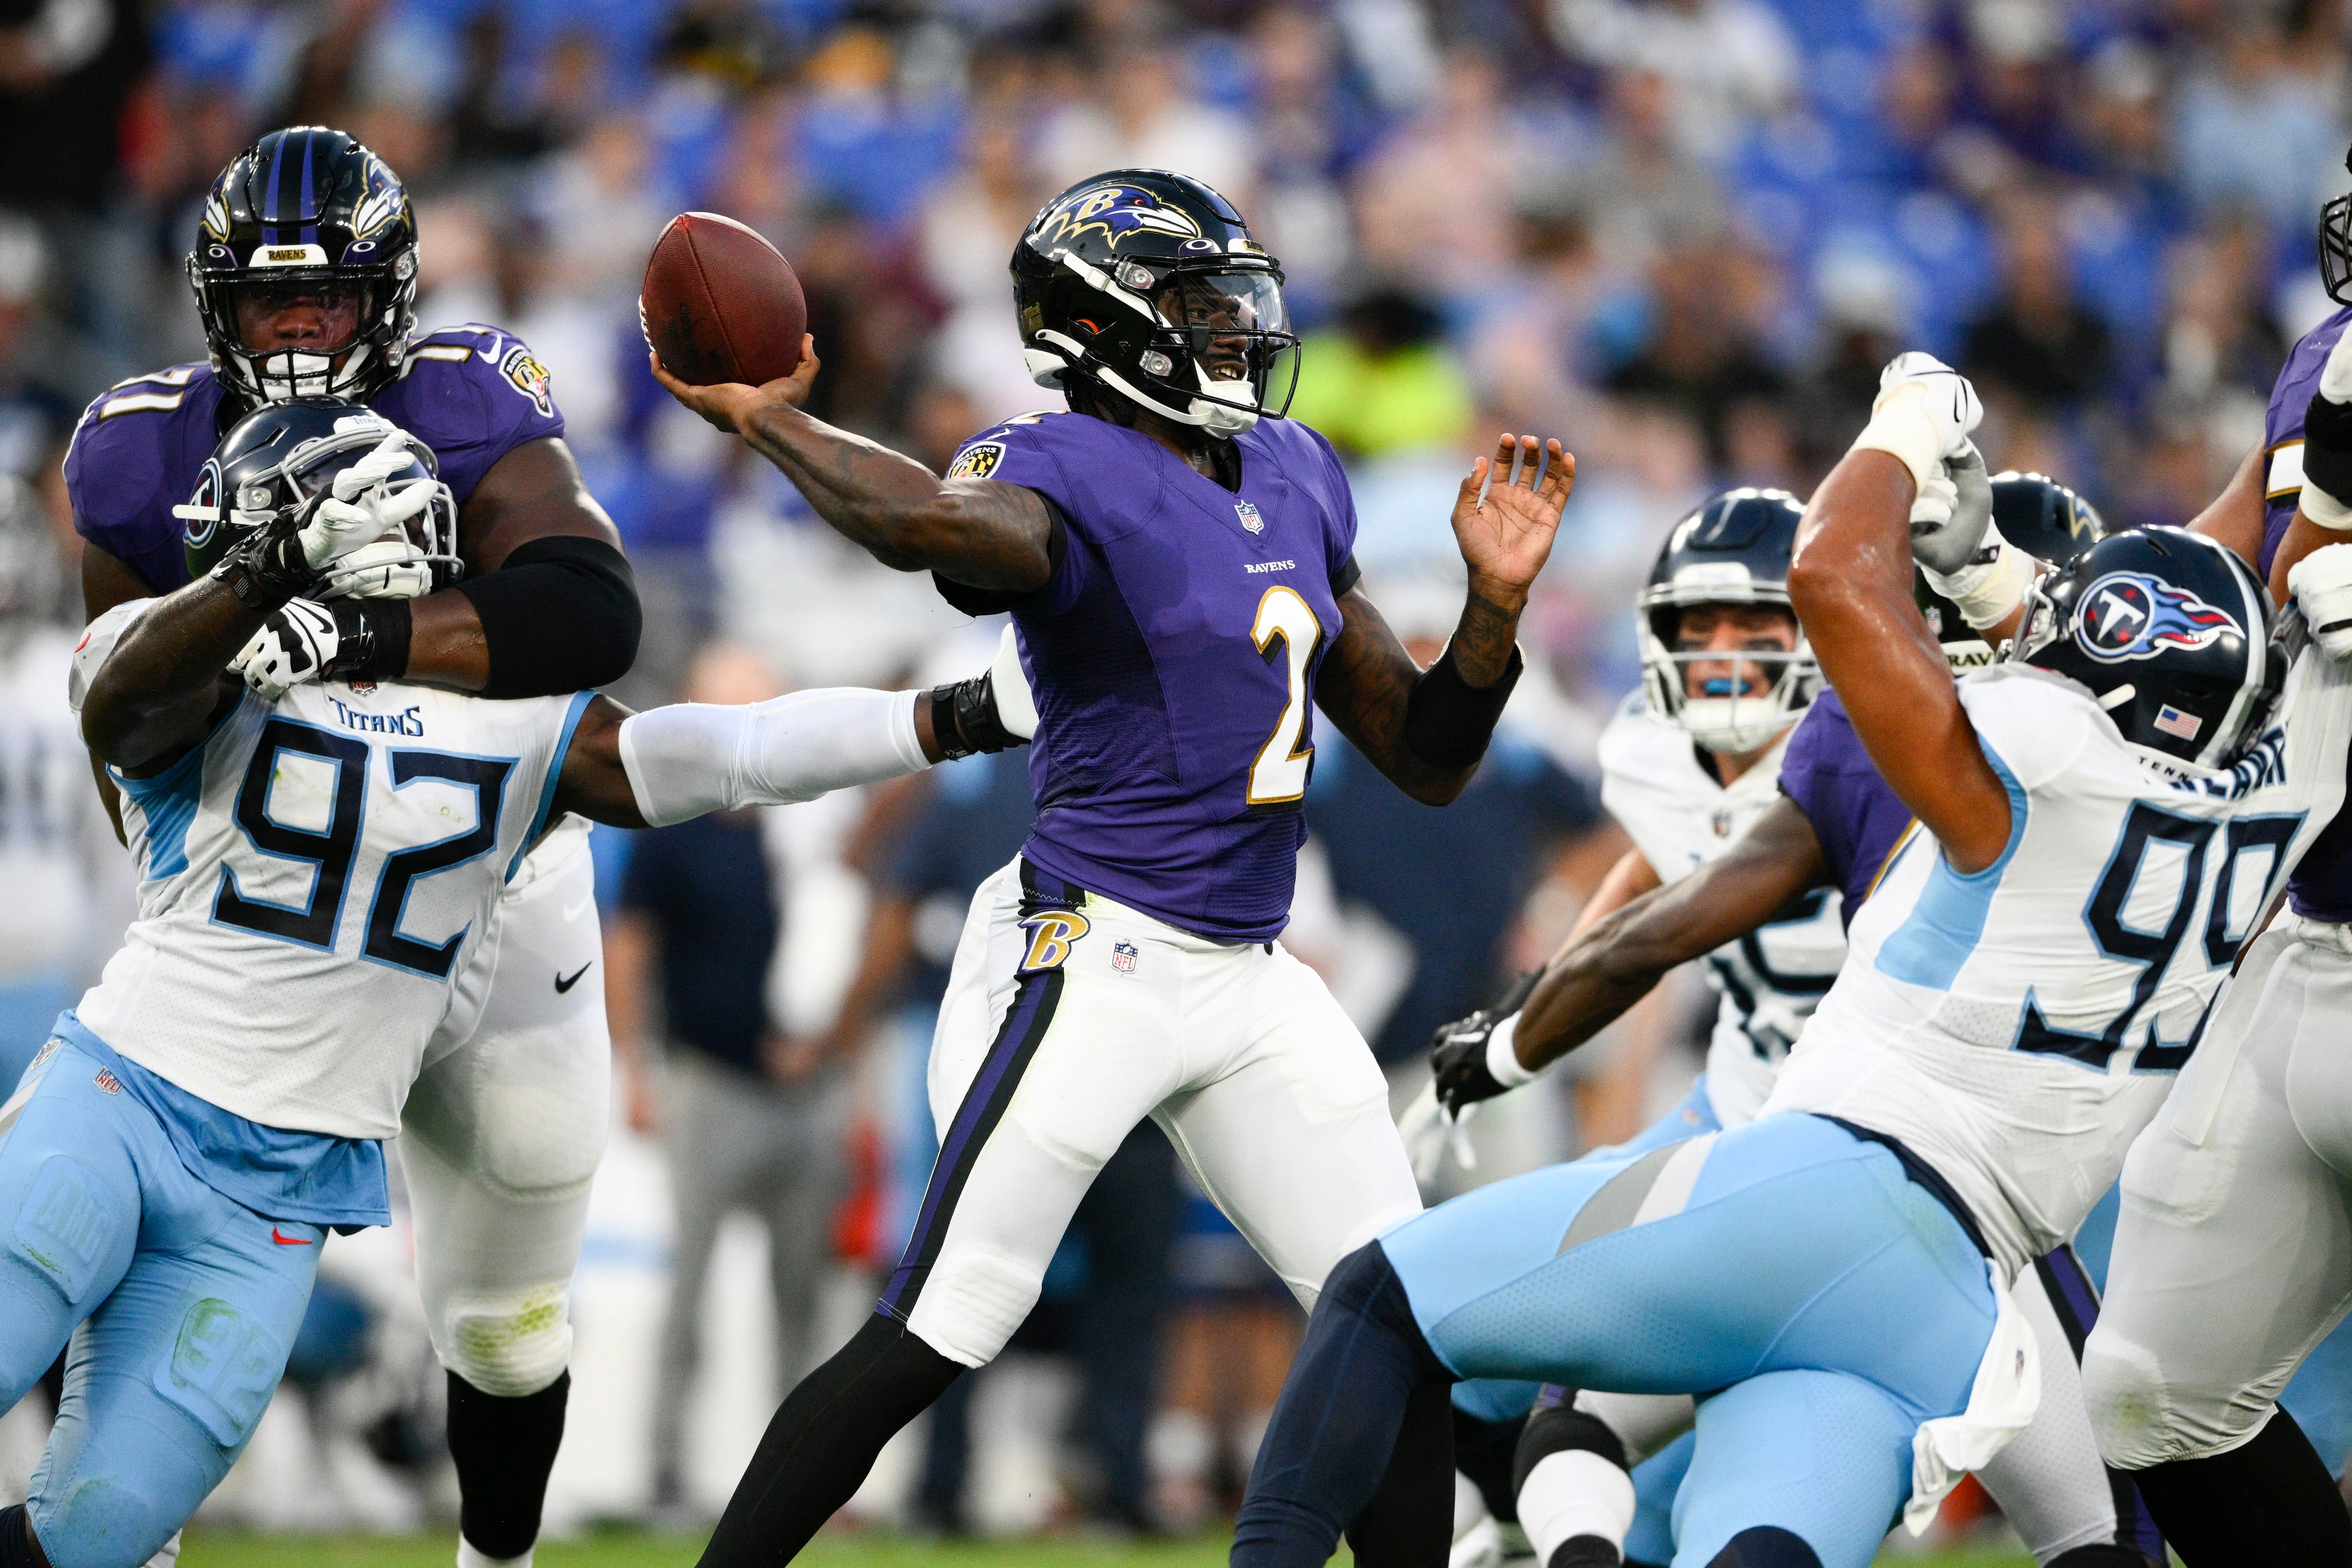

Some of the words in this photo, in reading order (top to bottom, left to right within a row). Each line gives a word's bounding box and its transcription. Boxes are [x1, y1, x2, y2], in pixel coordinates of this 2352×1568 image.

[268, 249, 306, 261] RAVENS
[1244, 515, 1261, 528] NFL
[1244, 560, 1295, 573] RAVENS
[1947, 652, 1994, 666] RAV
[1247, 586, 1321, 810] 2
[327, 695, 423, 736] TITANS
[208, 715, 520, 983] 92
[1017, 910, 1091, 974] B
[2009, 798, 2310, 1076] 99
[1114, 953, 1134, 969] NFL
[98, 1075, 117, 1091] NFL
